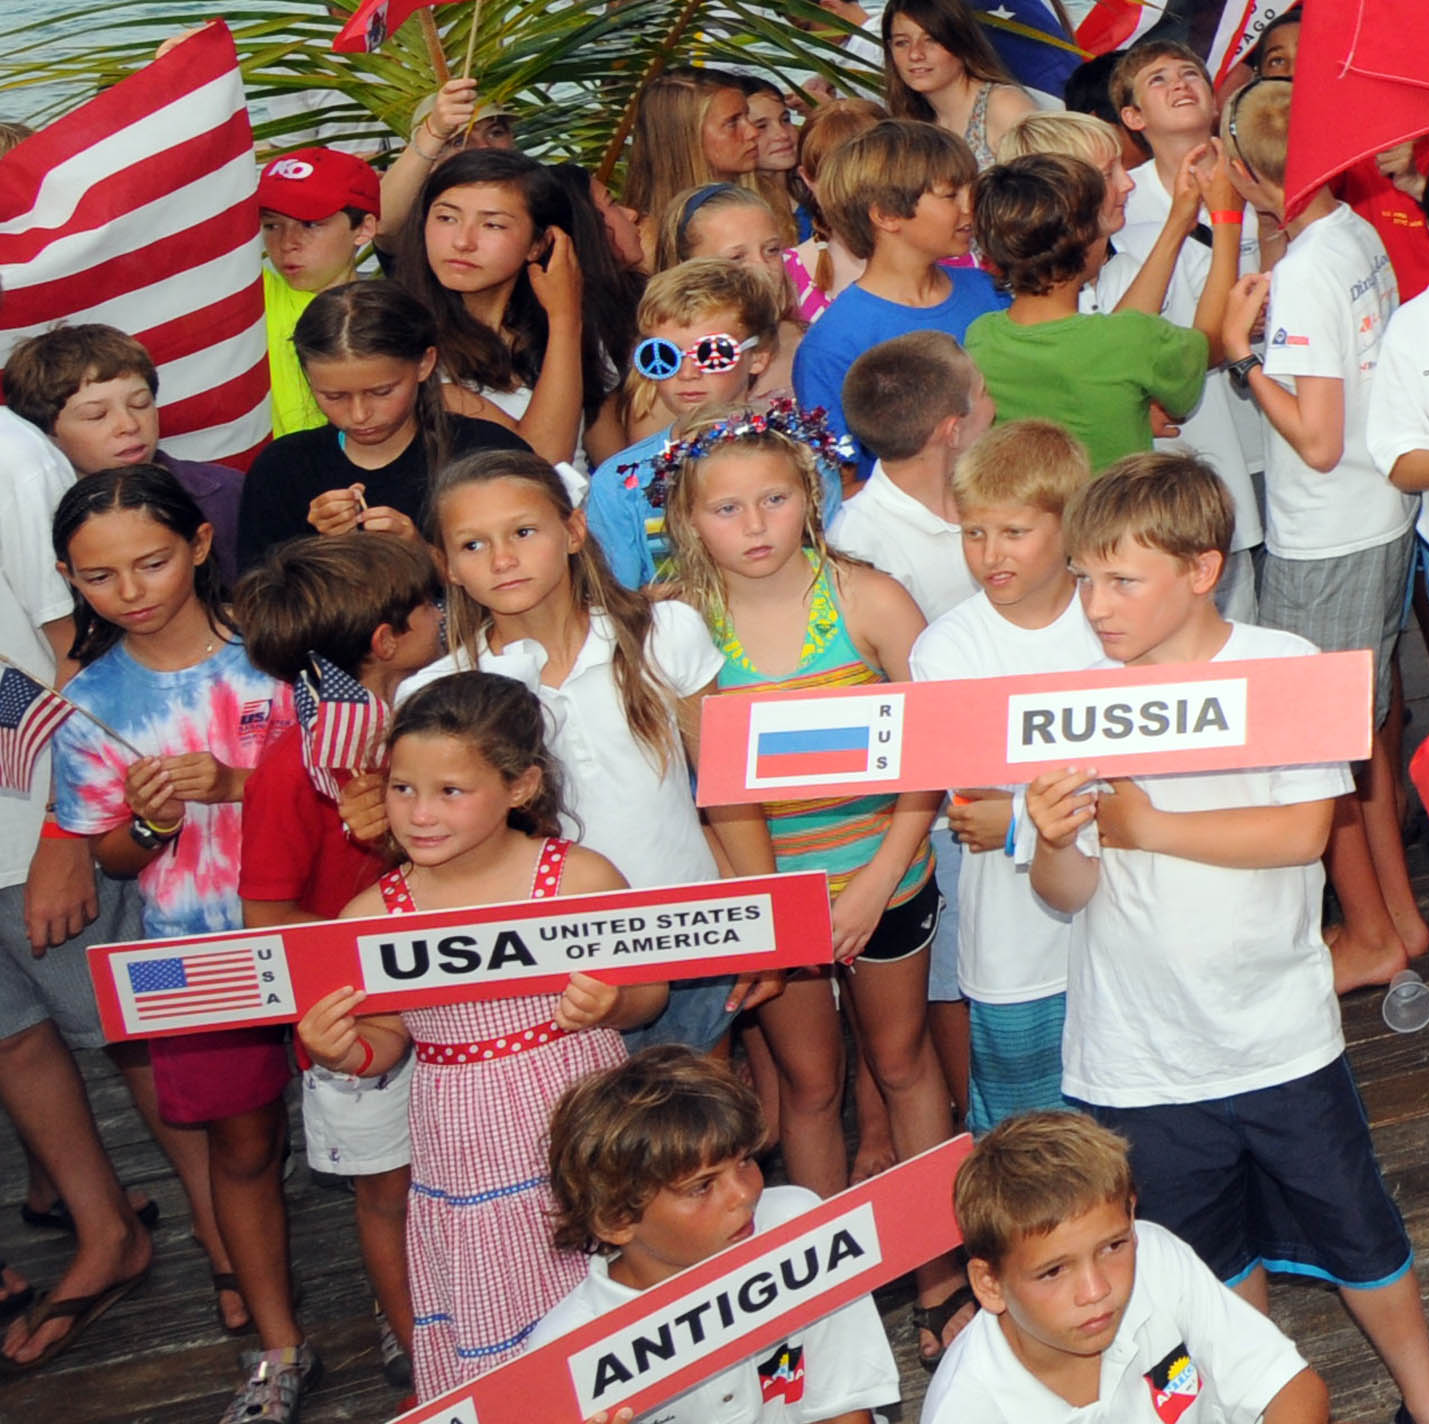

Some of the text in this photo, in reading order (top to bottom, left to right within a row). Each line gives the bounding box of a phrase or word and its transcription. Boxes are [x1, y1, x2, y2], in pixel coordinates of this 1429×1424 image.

[875, 703, 893, 771] RUS
[1021, 695, 1231, 746] RUSSIA
[539, 905, 762, 942] UNITED STATES
[565, 928, 740, 961] OF AMERICA
[256, 948, 282, 1006] USA
[379, 929, 538, 980] USA
[591, 1228, 866, 1401] ANTIGUA
